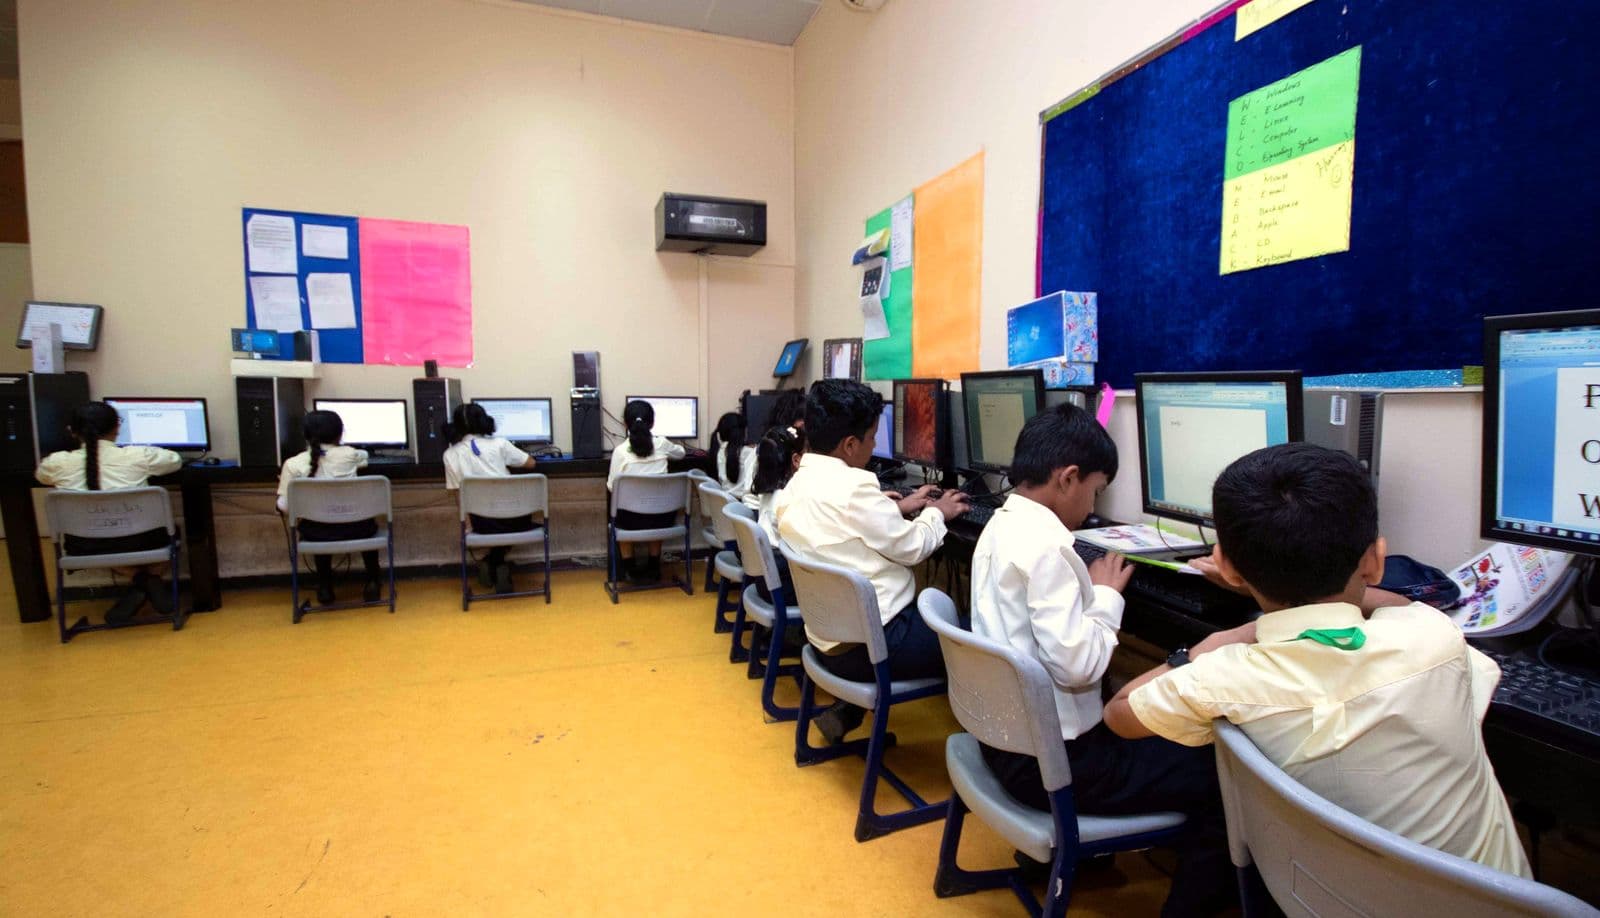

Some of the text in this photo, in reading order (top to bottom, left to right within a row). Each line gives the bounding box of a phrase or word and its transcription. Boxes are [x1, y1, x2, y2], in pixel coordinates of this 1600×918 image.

[1241, 99, 1250, 112] W
[1266, 81, 1301, 99] Windows
[1240, 115, 1247, 126] E
[1236, 147, 1242, 157] C
[1263, 127, 1298, 144] Computer
[1239, 130, 1245, 141] L
[1263, 172, 1288, 182] Mouse
[1233, 198, 1240, 207] E
[1233, 201, 1299, 224] B Backspace
[1231, 217, 1278, 238] A Apple
[1230, 248, 1293, 269] K Keyboard
